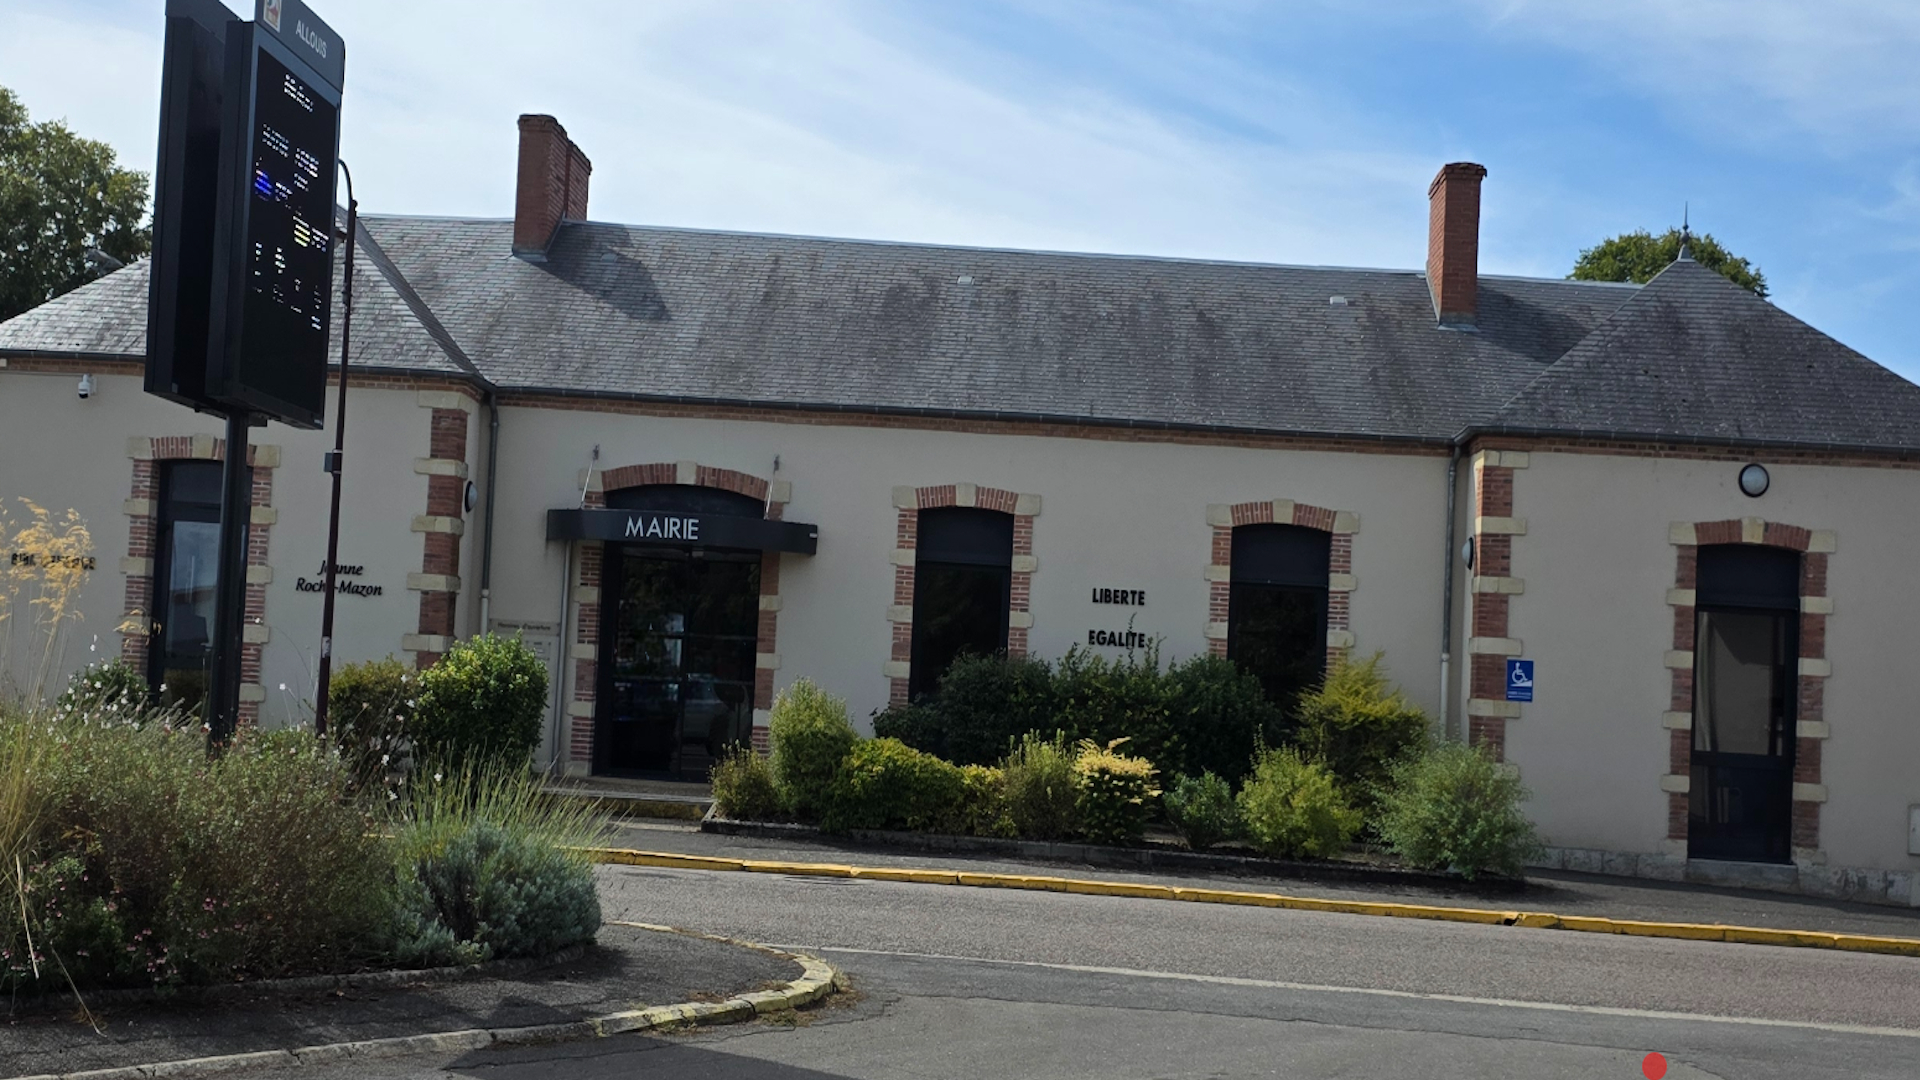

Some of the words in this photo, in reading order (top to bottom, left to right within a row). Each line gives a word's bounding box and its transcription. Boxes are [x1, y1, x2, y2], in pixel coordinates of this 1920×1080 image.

[296, 20, 327, 58] ALLOUIS
[625, 515, 699, 540] MAIRIE
[317, 560, 363, 575] Janne
[295, 577, 382, 597] Roch-Mazon
[1092, 587, 1145, 606] LIBERTE
[1088, 629, 1145, 648] EGALITE
